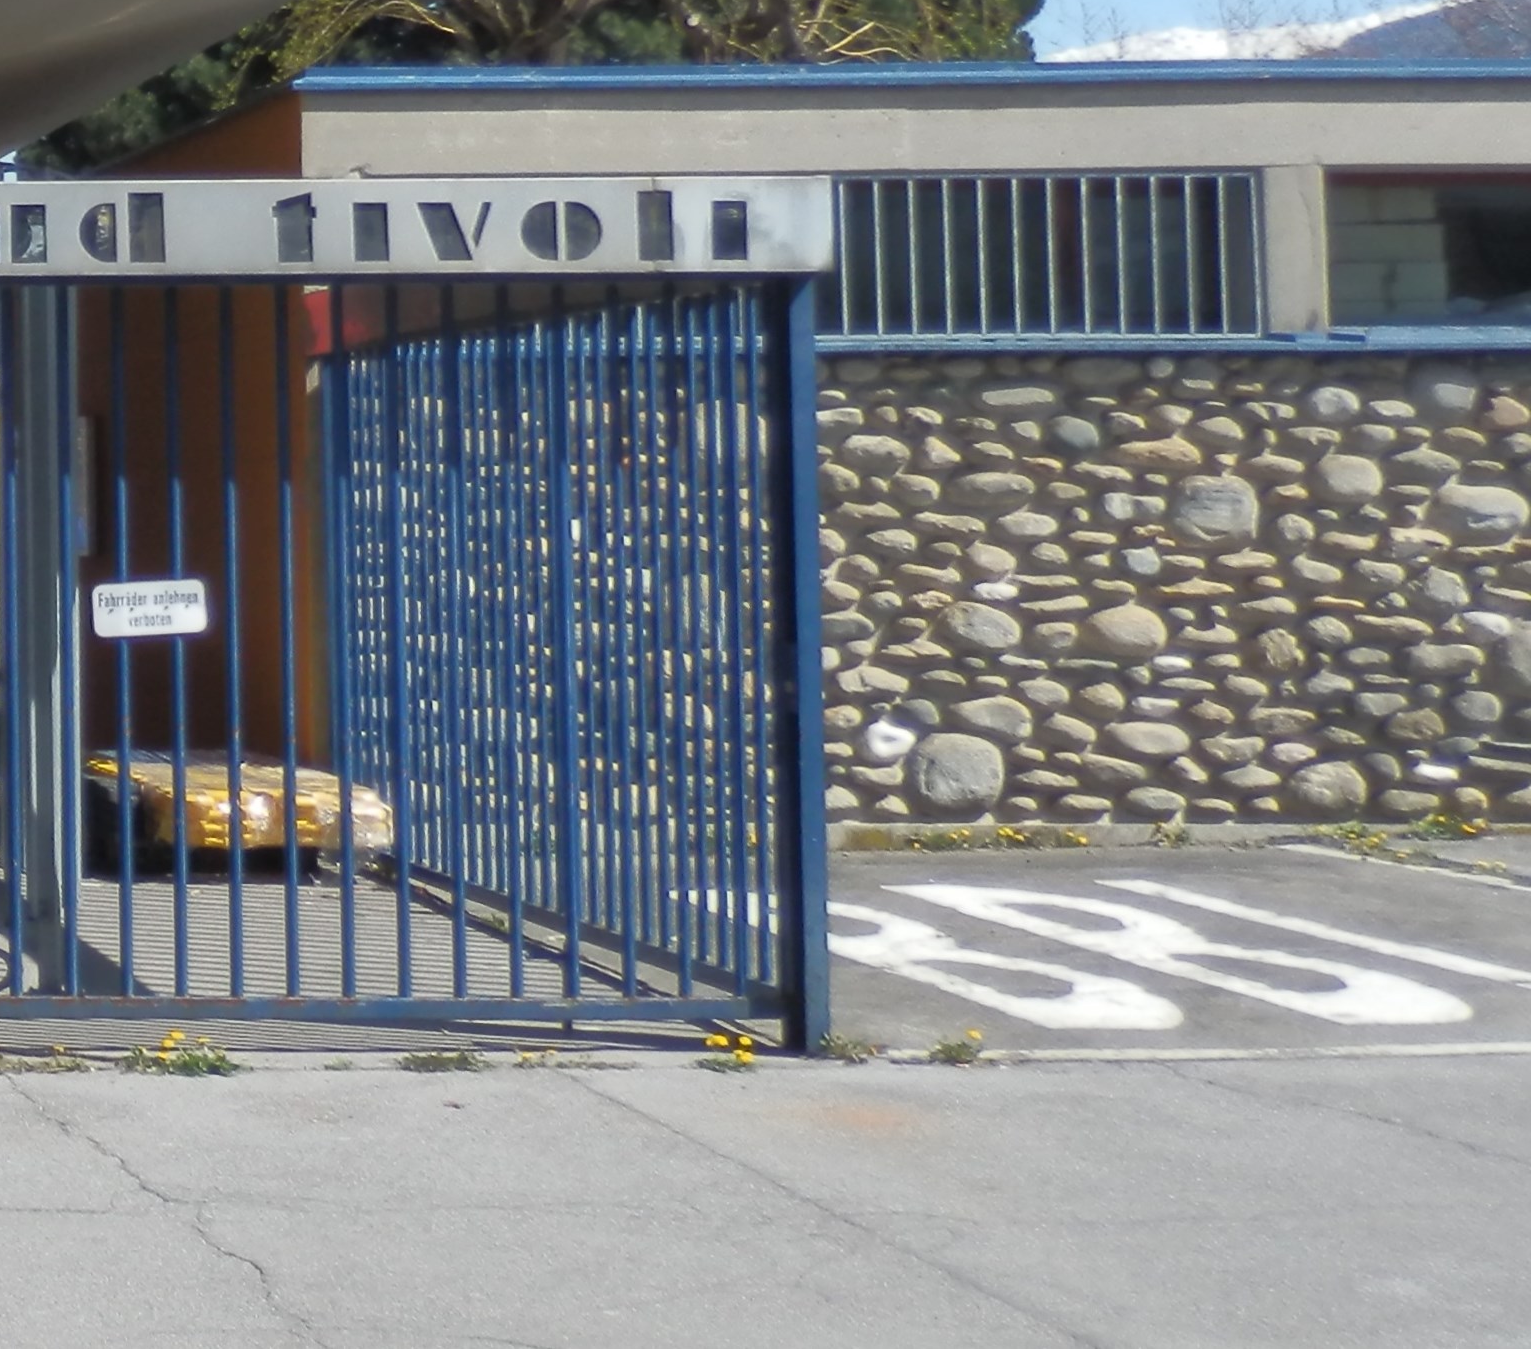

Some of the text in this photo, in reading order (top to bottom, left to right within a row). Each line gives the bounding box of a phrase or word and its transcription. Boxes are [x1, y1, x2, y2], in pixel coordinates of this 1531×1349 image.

[272, 191, 748, 263] tivoli
[153, 590, 198, 605] anlehnen
[129, 614, 172, 627] verboten
